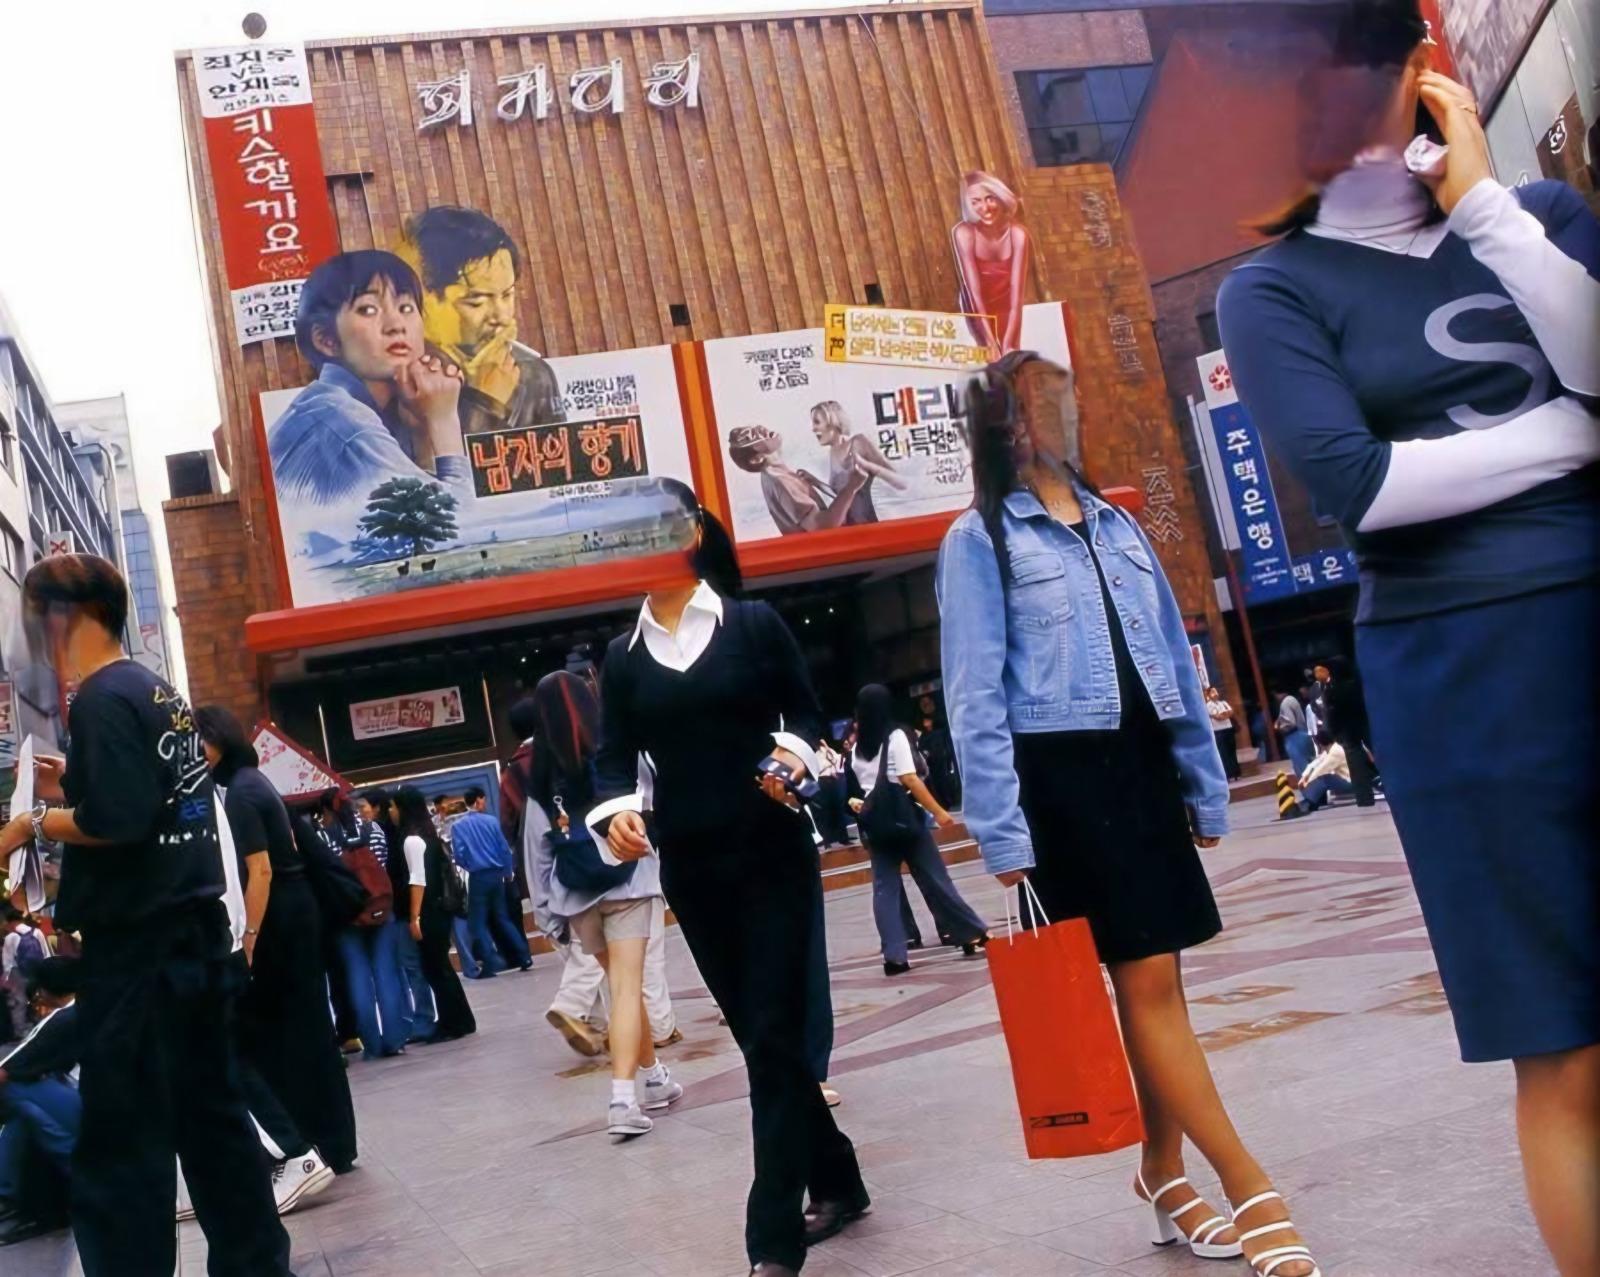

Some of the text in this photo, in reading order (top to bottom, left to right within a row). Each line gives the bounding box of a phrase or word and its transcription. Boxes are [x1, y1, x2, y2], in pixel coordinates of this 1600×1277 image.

[233, 108, 303, 255] 키스할까요
[1424, 292, 1551, 430] S
[471, 418, 642, 493] 남자의 향기
[1226, 427, 1275, 550] 주택은행
